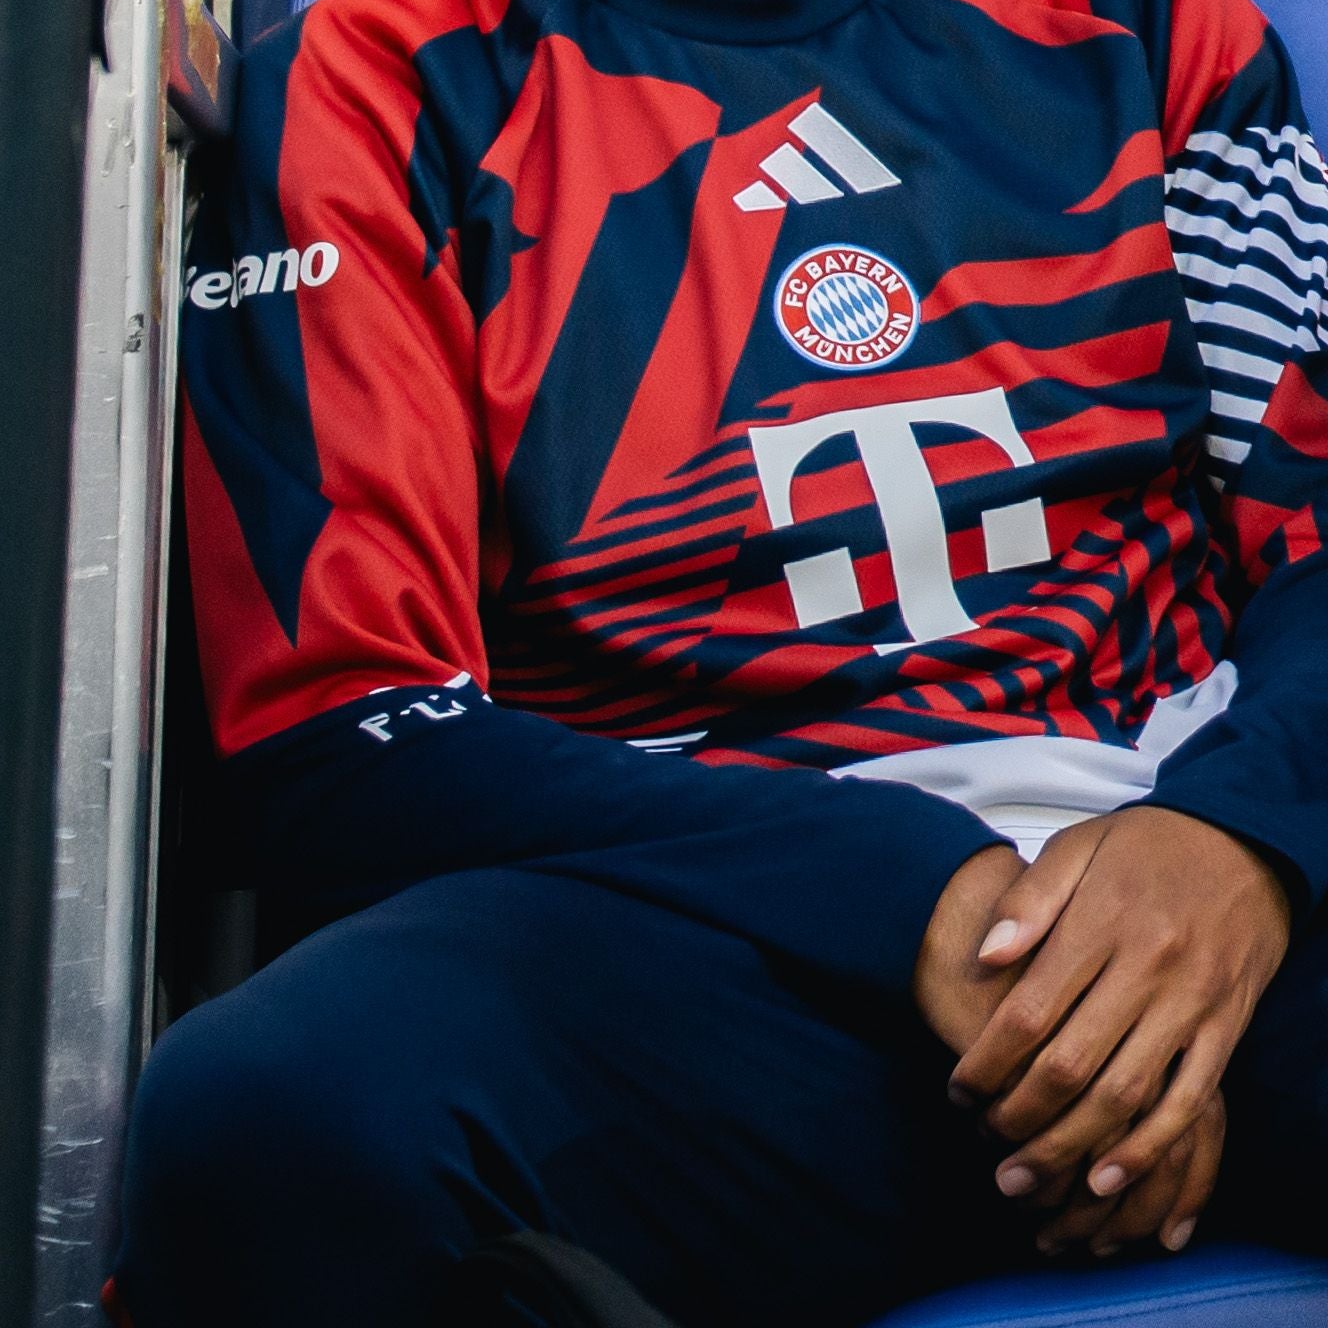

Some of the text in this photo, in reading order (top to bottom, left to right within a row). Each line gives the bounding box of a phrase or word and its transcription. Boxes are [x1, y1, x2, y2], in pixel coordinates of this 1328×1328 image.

[784, 253, 904, 309] FC BAYERN
[793, 312, 912, 363] MÜNCHEN
[748, 387, 1052, 656] T
